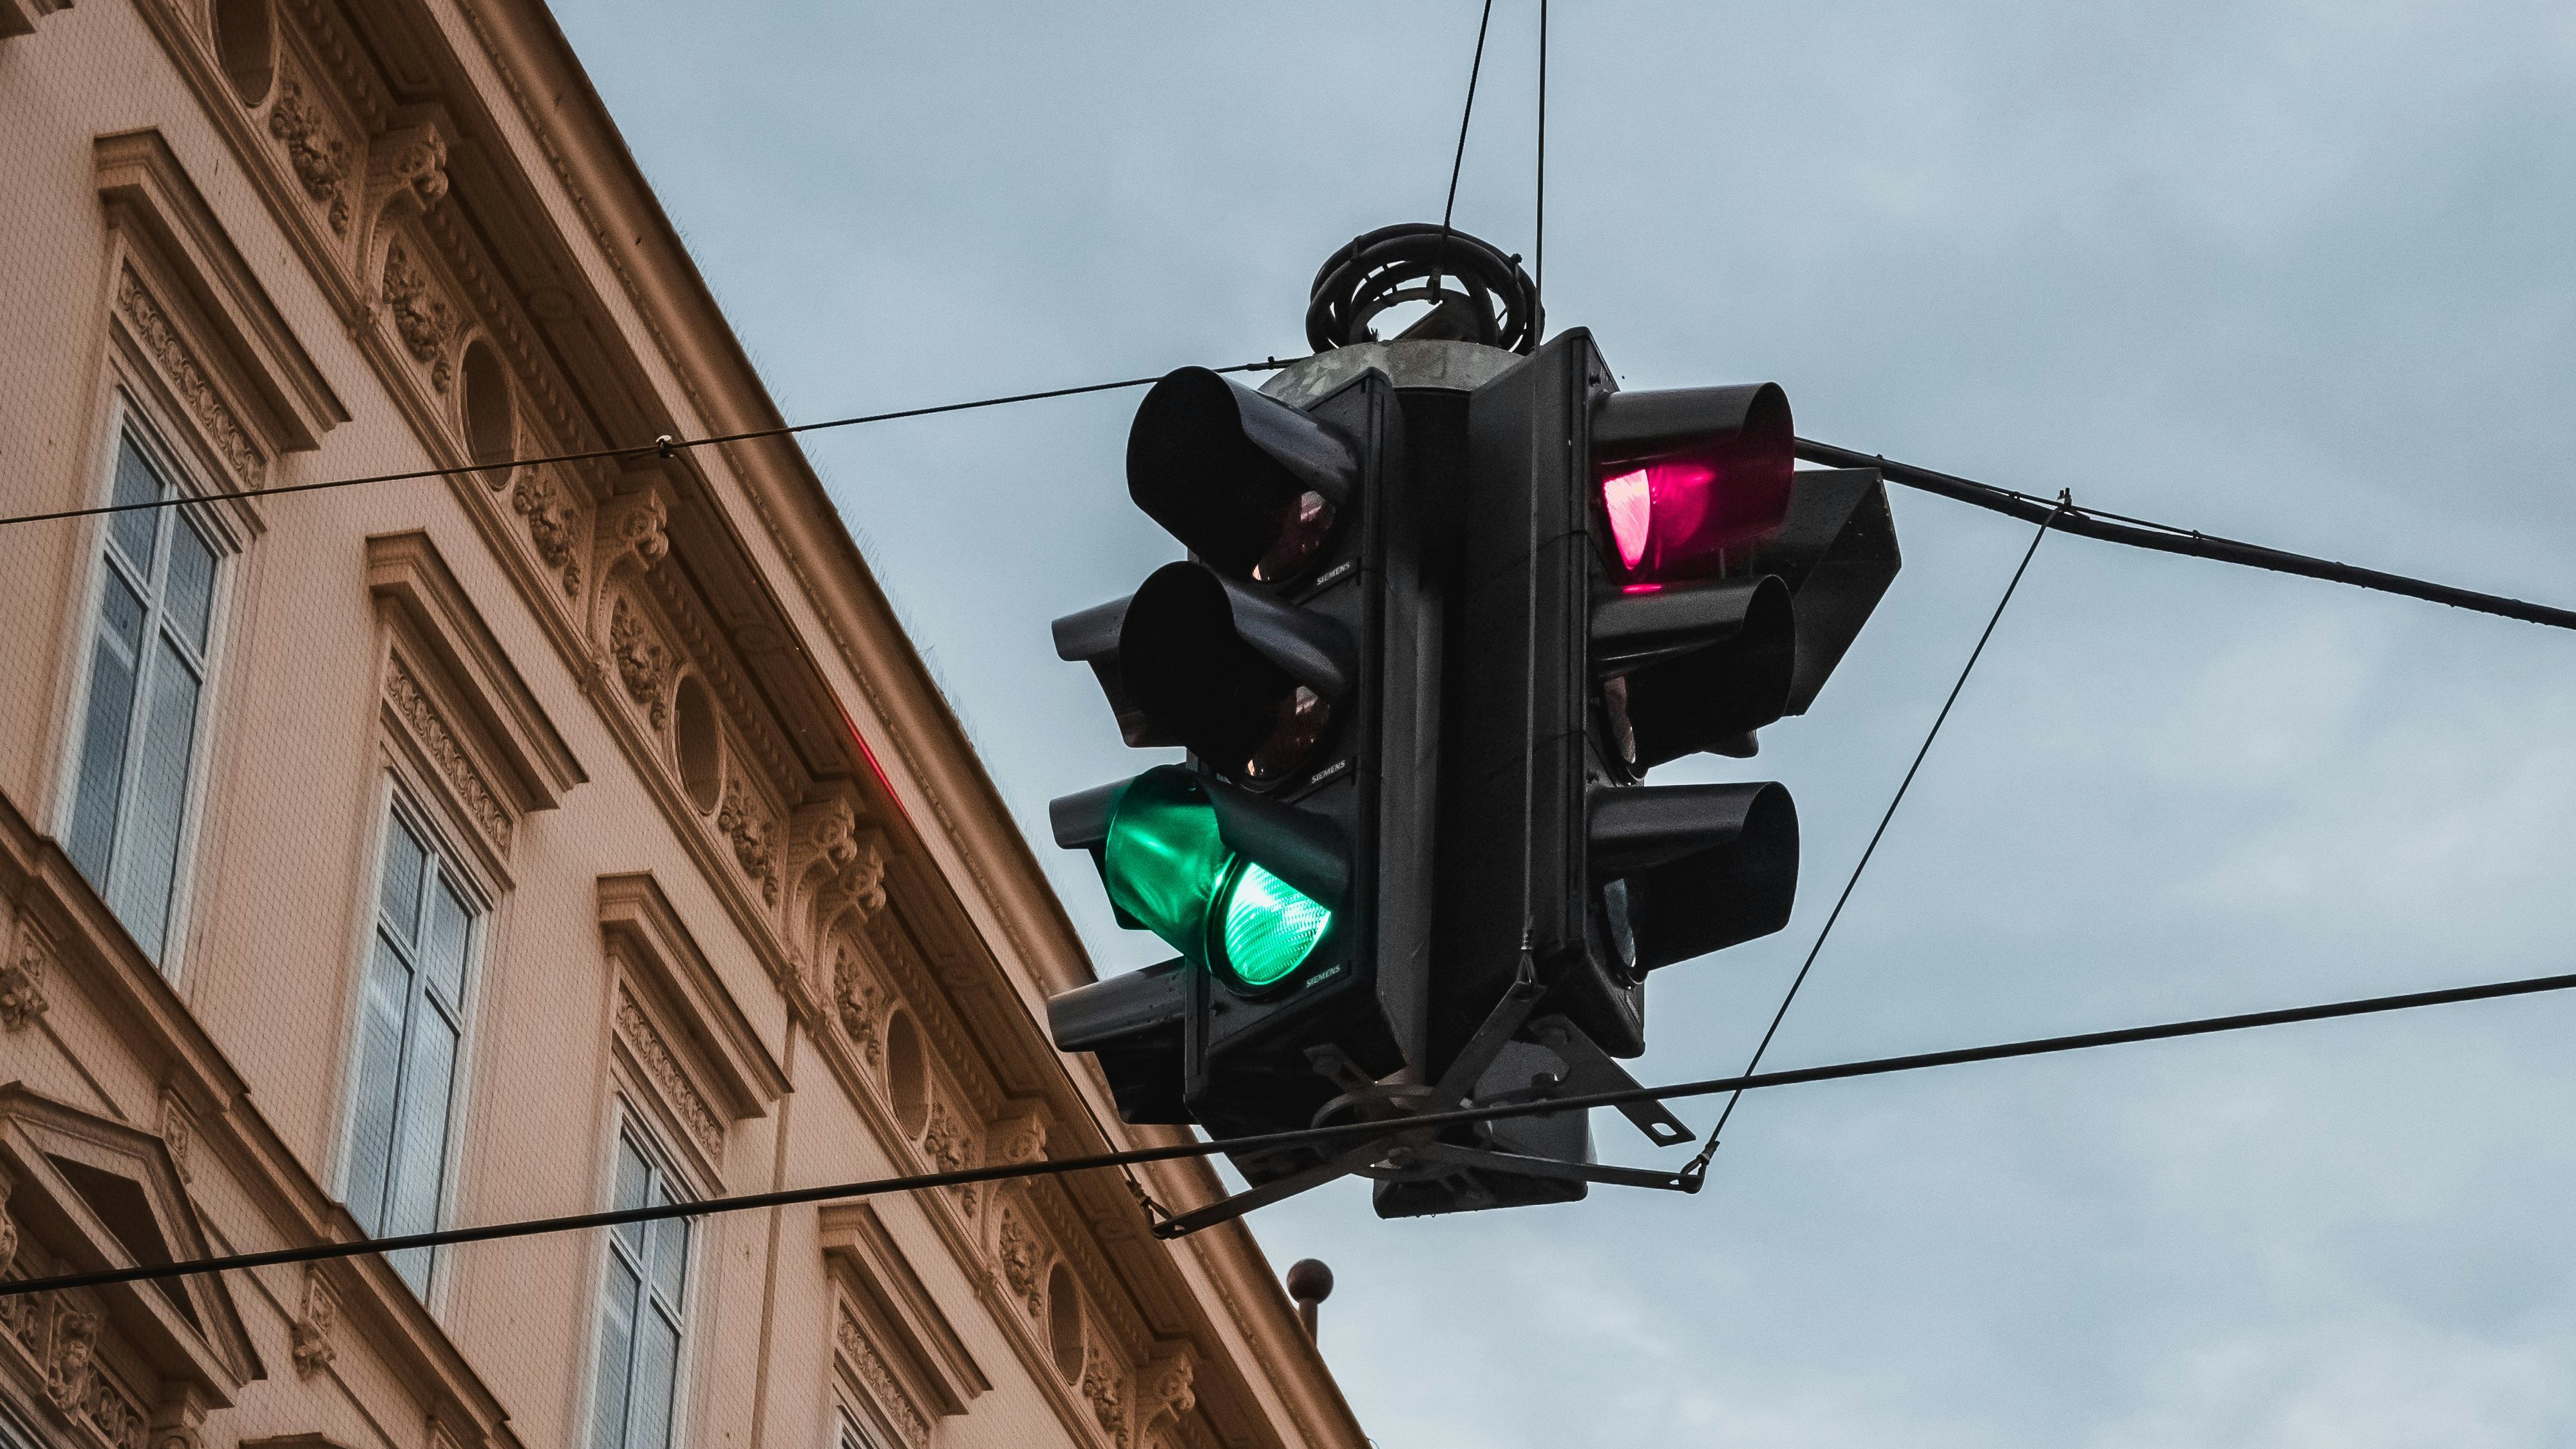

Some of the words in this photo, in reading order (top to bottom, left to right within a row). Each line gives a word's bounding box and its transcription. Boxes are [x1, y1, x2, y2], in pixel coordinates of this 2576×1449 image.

[1316, 562, 1350, 585] SIEMENS
[1312, 760, 1345, 784] SIEMENS
[1306, 964, 1340, 989] SIEMENS
